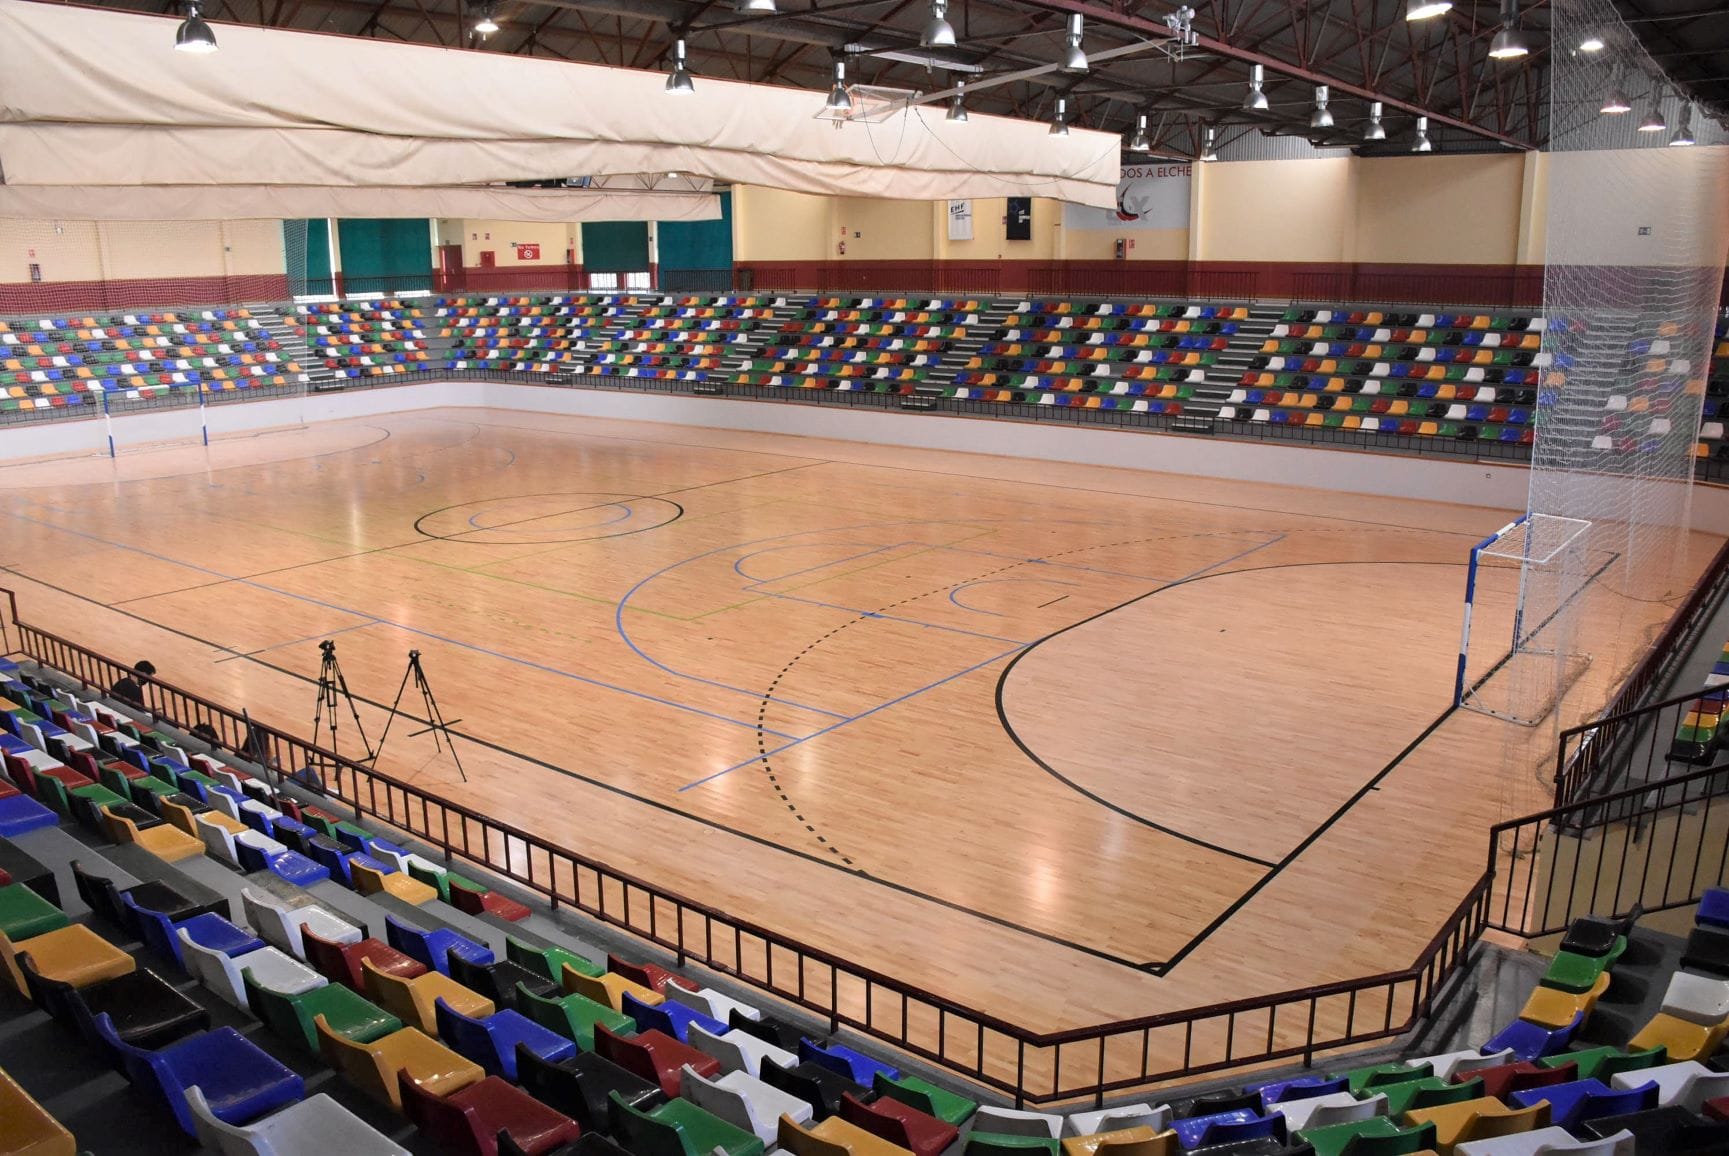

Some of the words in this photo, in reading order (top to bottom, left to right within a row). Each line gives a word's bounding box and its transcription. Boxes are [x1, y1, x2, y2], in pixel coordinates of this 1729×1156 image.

[1145, 167, 1154, 178] A
[1157, 165, 1192, 178] ELCHE
[950, 202, 965, 213] EHF
